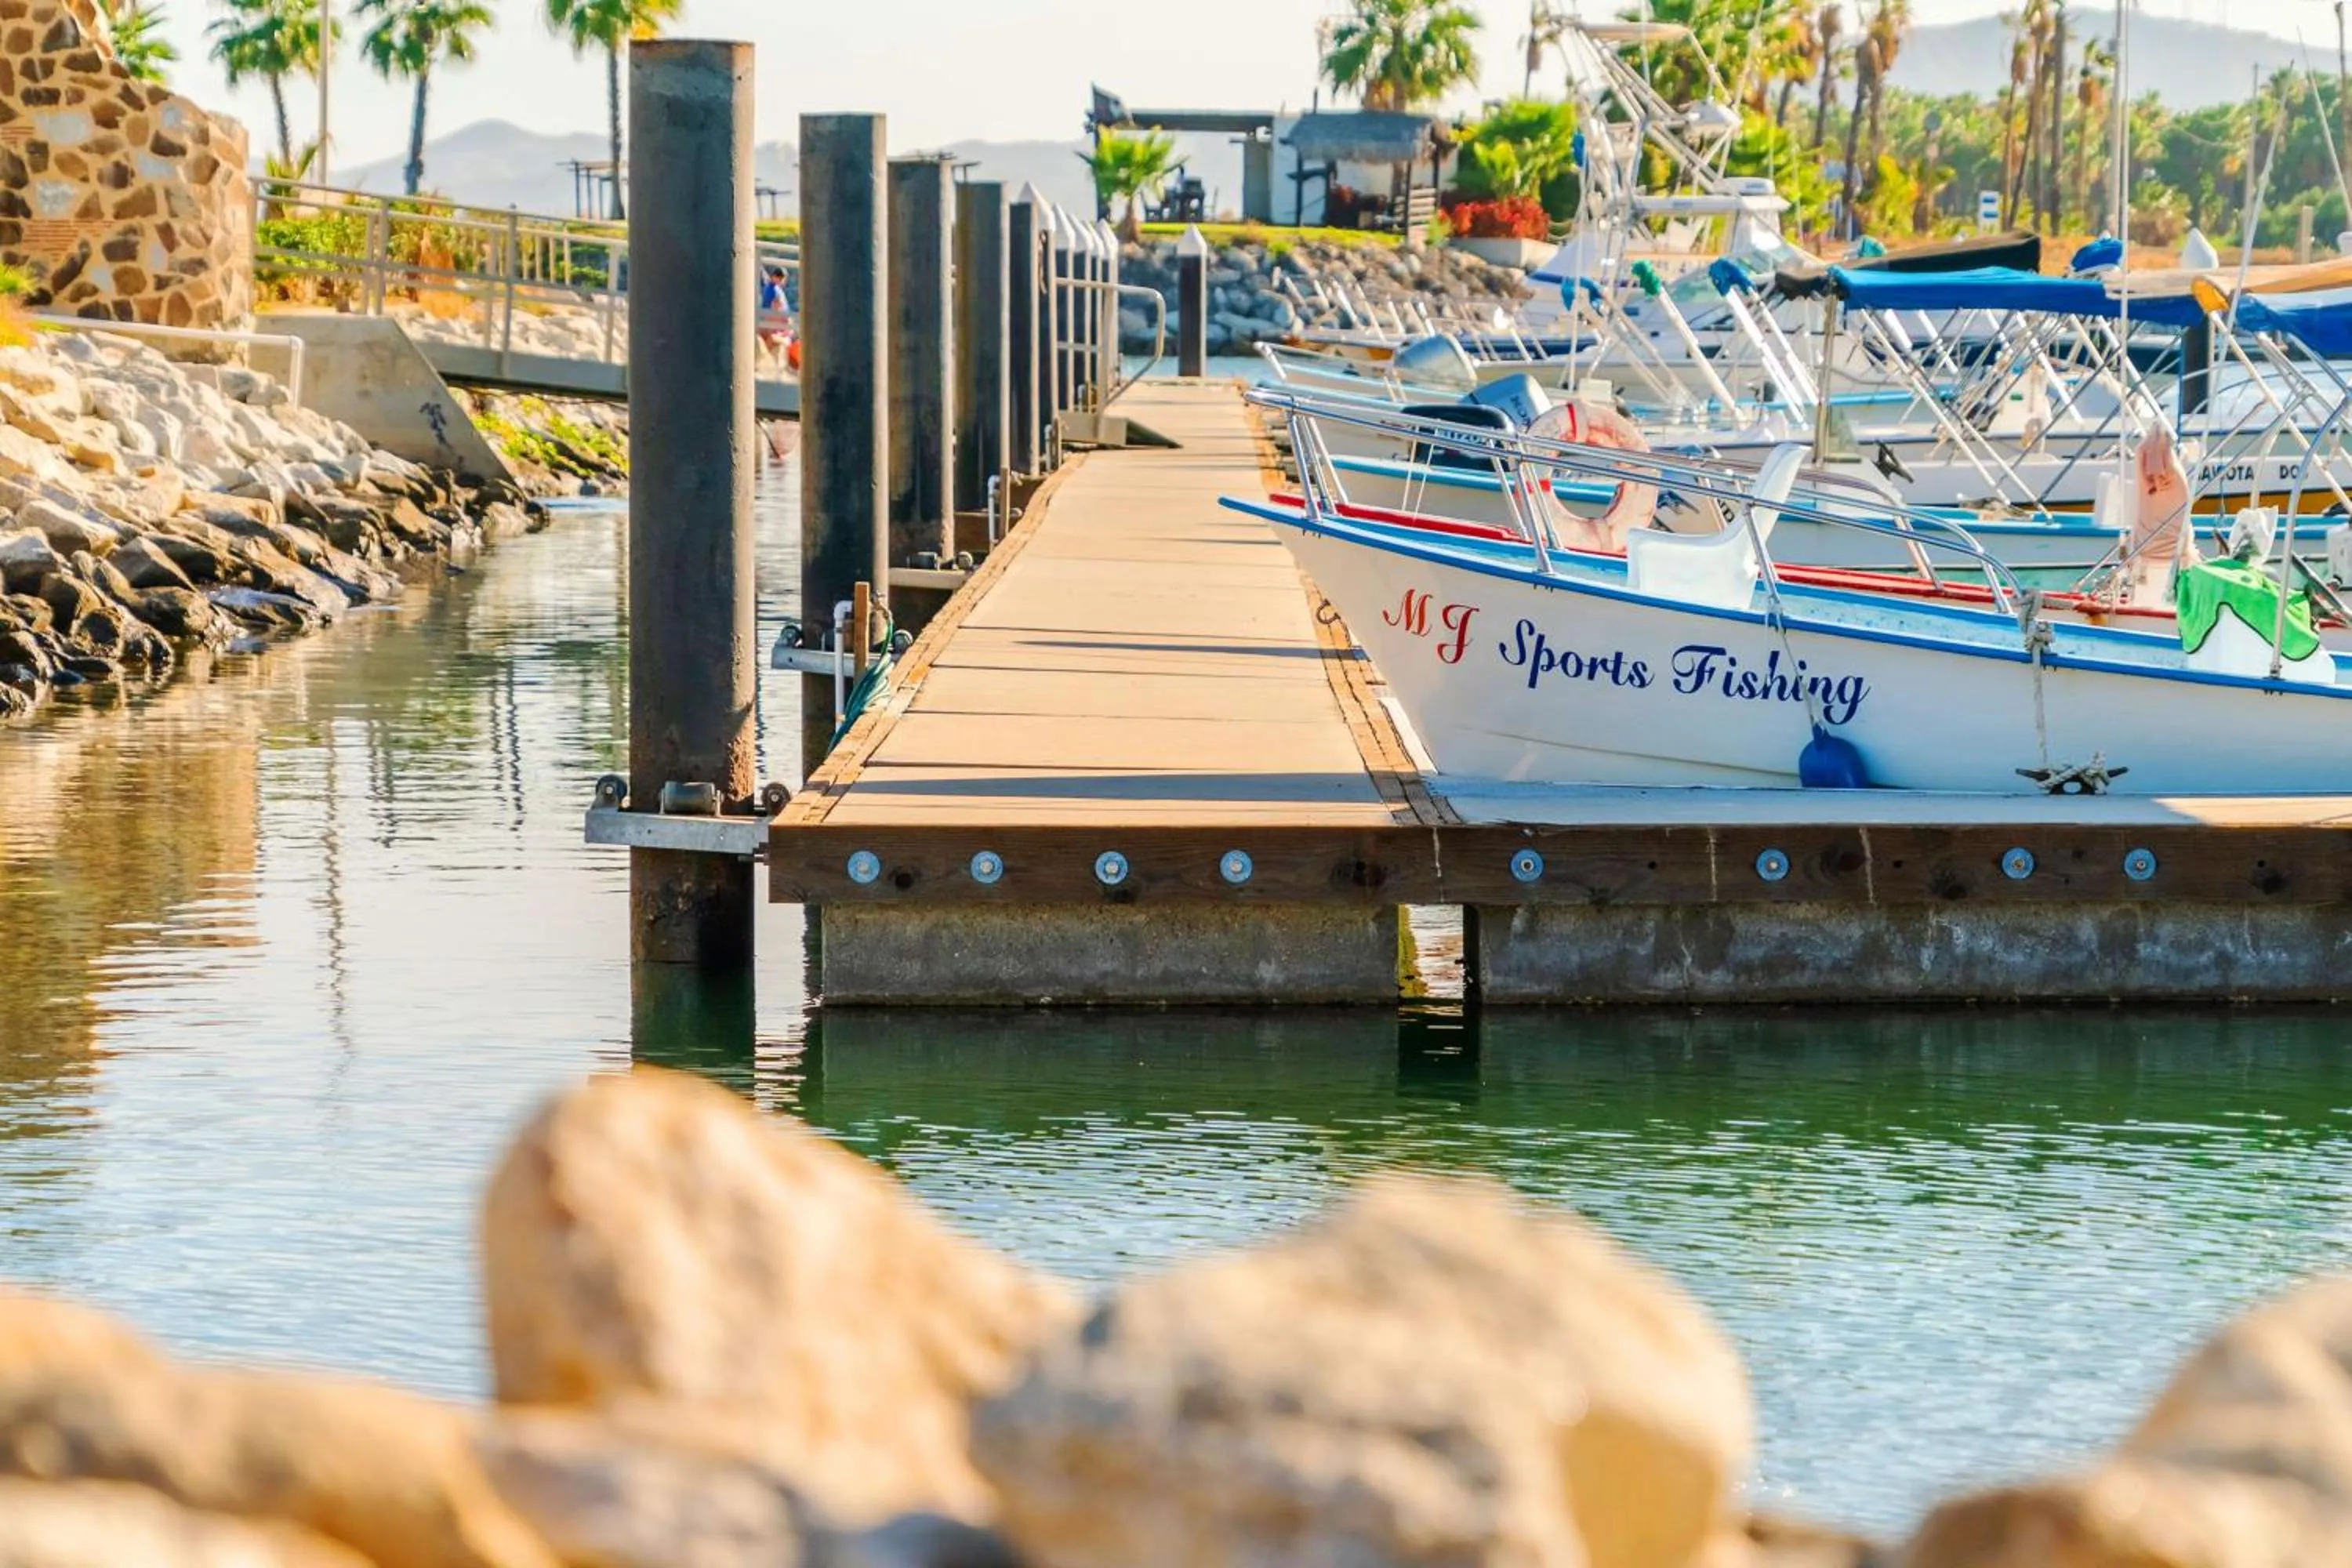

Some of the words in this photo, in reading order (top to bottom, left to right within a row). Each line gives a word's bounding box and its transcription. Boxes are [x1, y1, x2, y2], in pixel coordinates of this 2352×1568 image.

[2279, 464, 2309, 480] DO
[1498, 619, 1655, 688] Sports
[1671, 644, 1871, 725] Fishing
